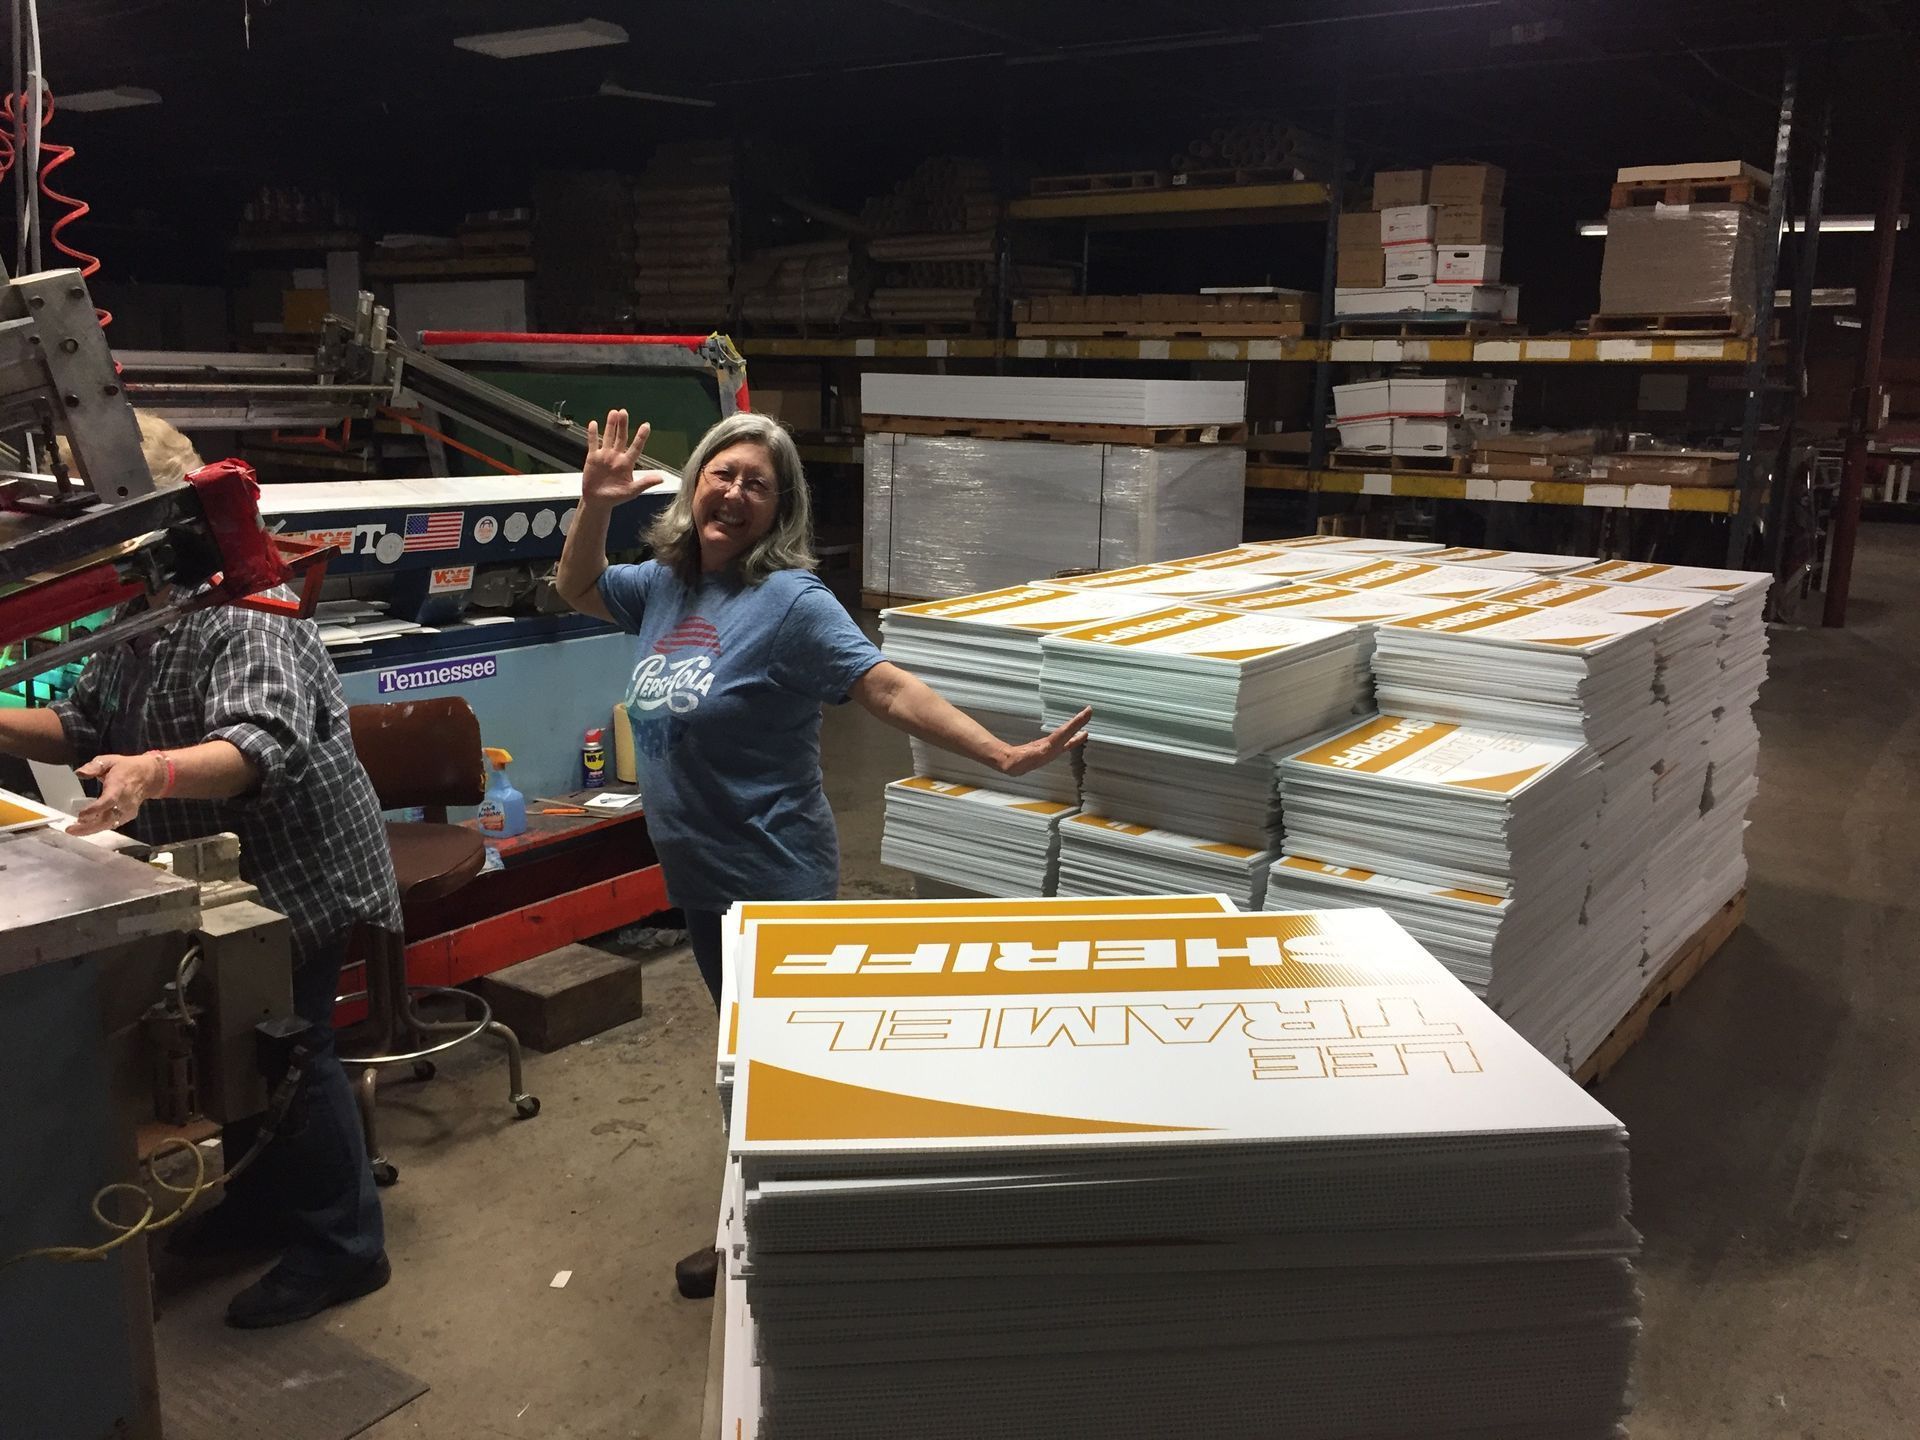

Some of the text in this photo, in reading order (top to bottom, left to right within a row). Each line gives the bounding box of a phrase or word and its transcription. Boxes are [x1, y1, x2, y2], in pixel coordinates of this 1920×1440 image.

[356, 524, 387, 554] T
[1092, 610, 1218, 643] SHERIFF
[1417, 603, 1519, 631] SHERIFF
[380, 660, 496, 692] Tennessee
[1329, 718, 1435, 768] SHERIFF
[787, 997, 1464, 1052] TRAMEL
[1248, 1041, 1484, 1080] LEE
